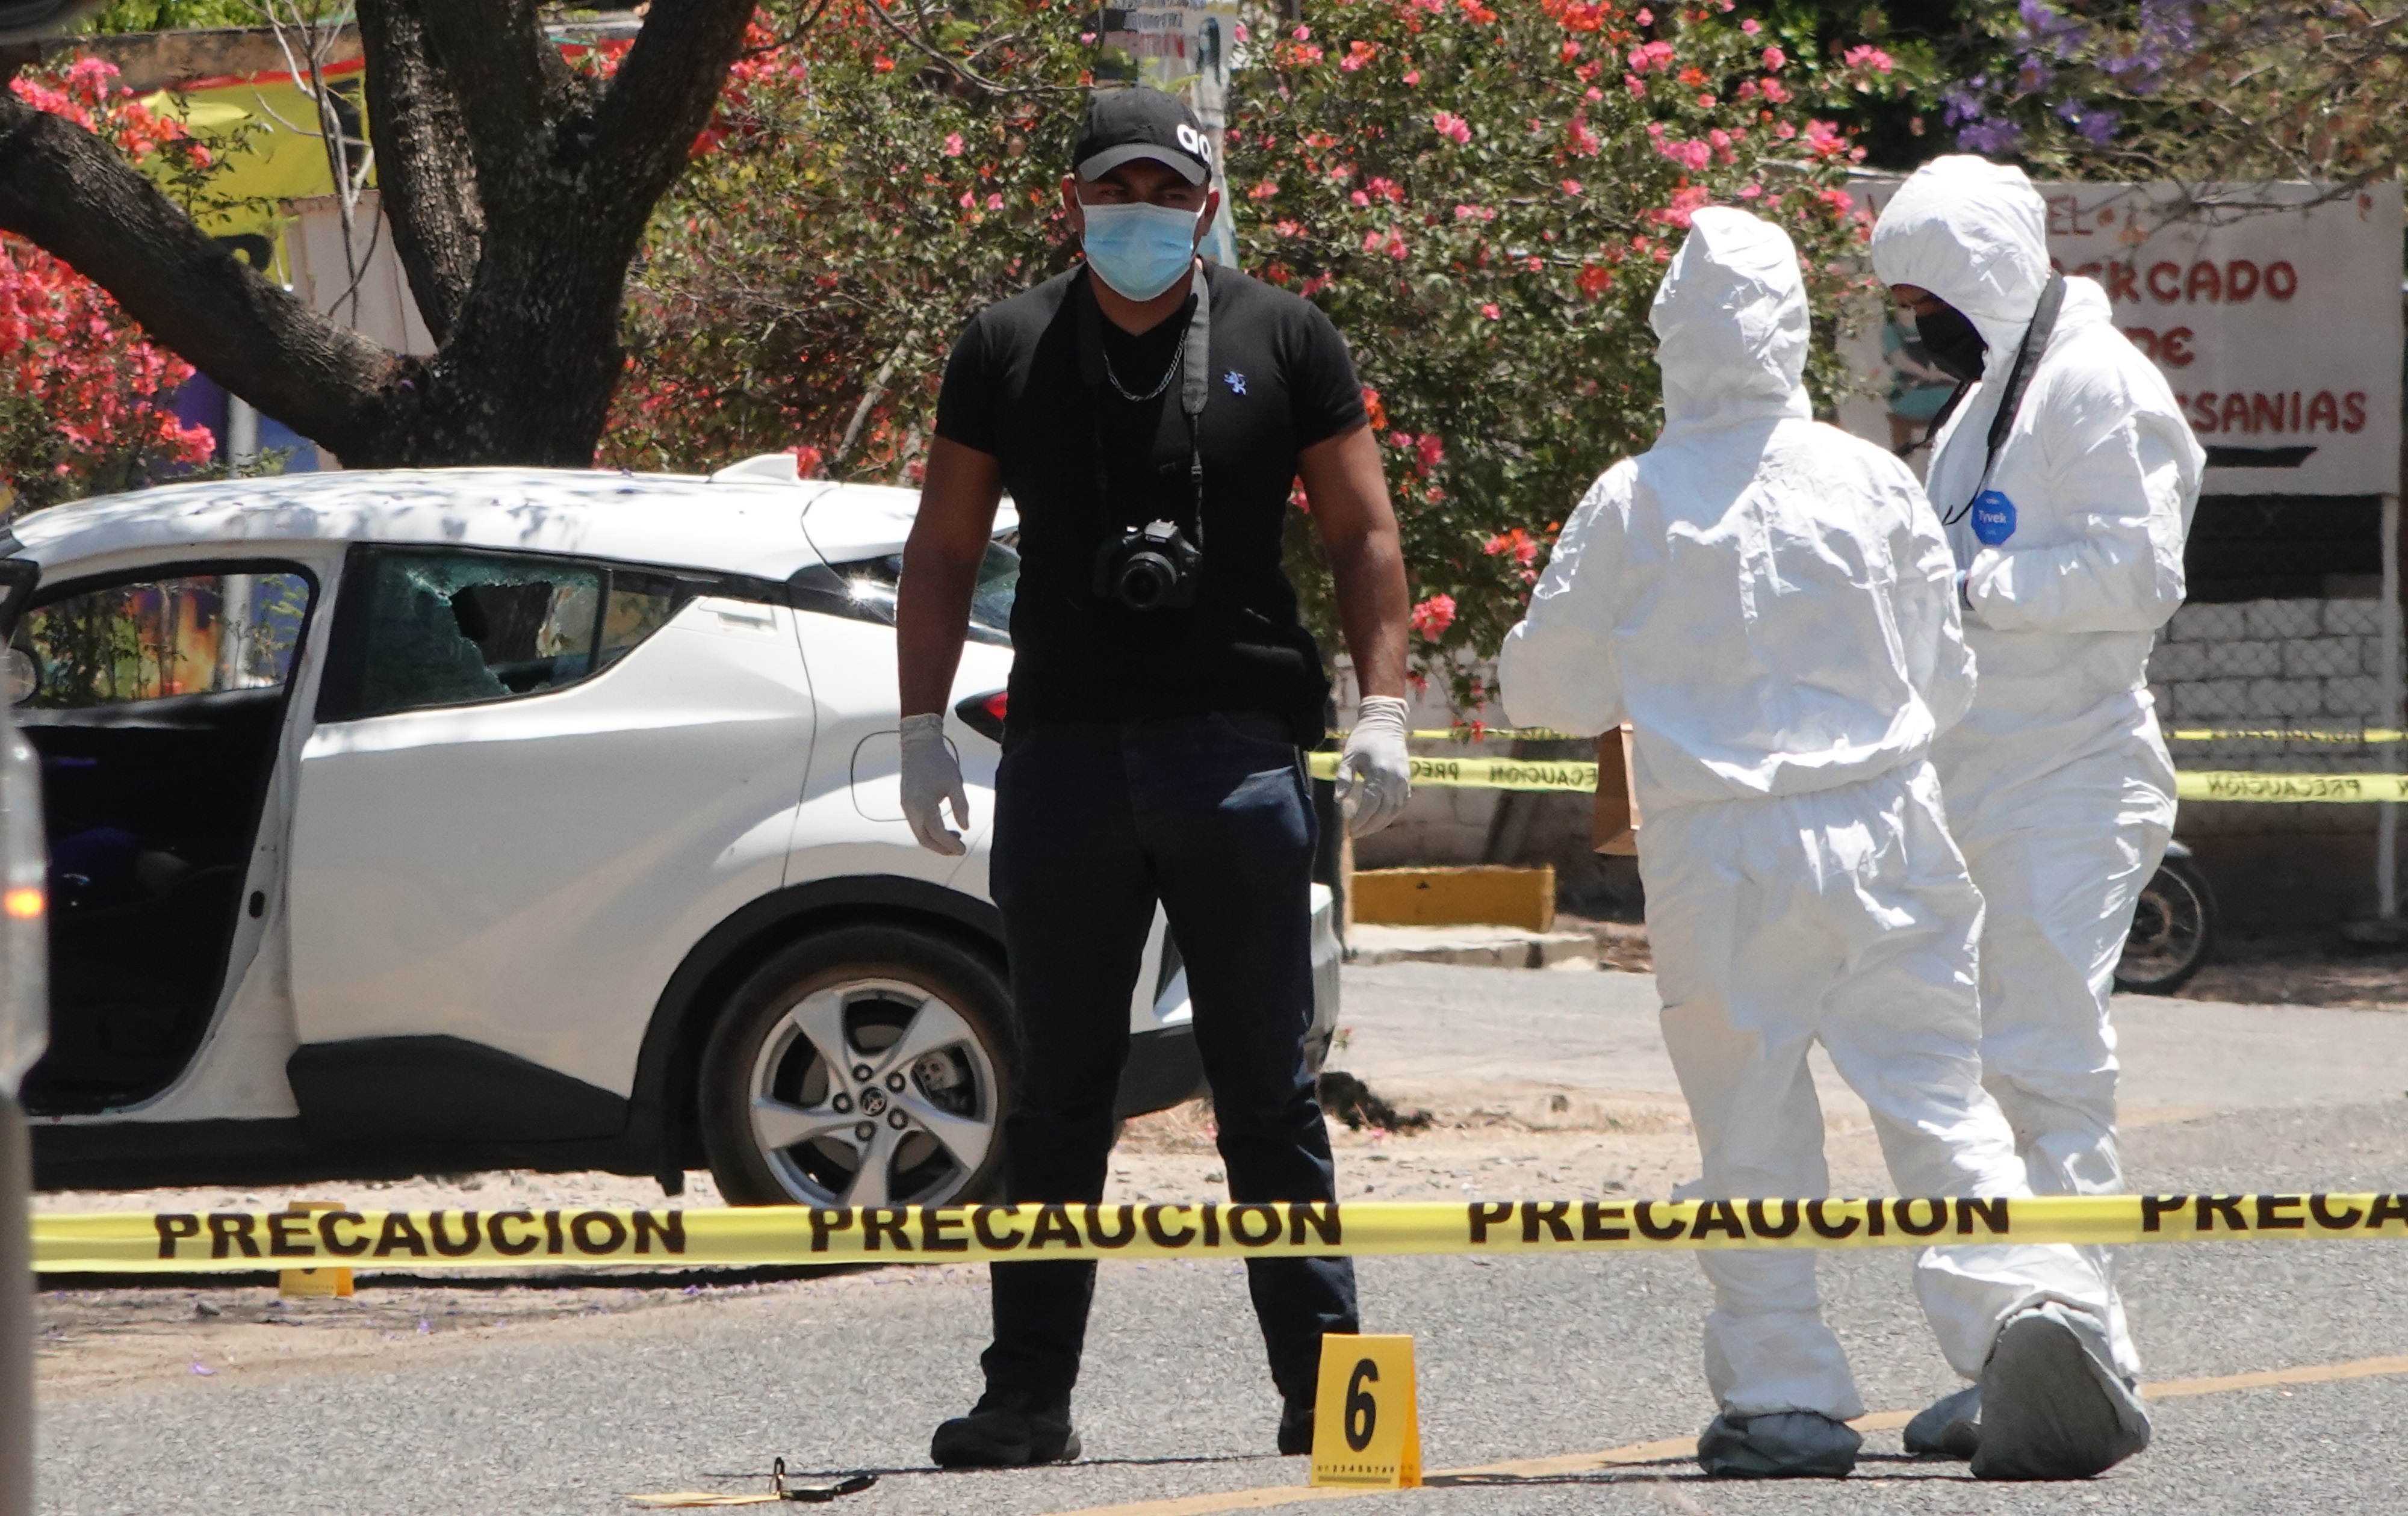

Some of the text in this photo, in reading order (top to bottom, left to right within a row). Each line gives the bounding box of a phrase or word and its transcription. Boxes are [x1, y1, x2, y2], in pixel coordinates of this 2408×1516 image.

[2051, 259, 2298, 303] RCADO
[1978, 510, 2006, 524] Tyvek
[154, 1195, 2408, 1260] PRECAUCION PRECAUCION PRECAUCION PRECA
[1344, 1358, 1378, 1452] 6
